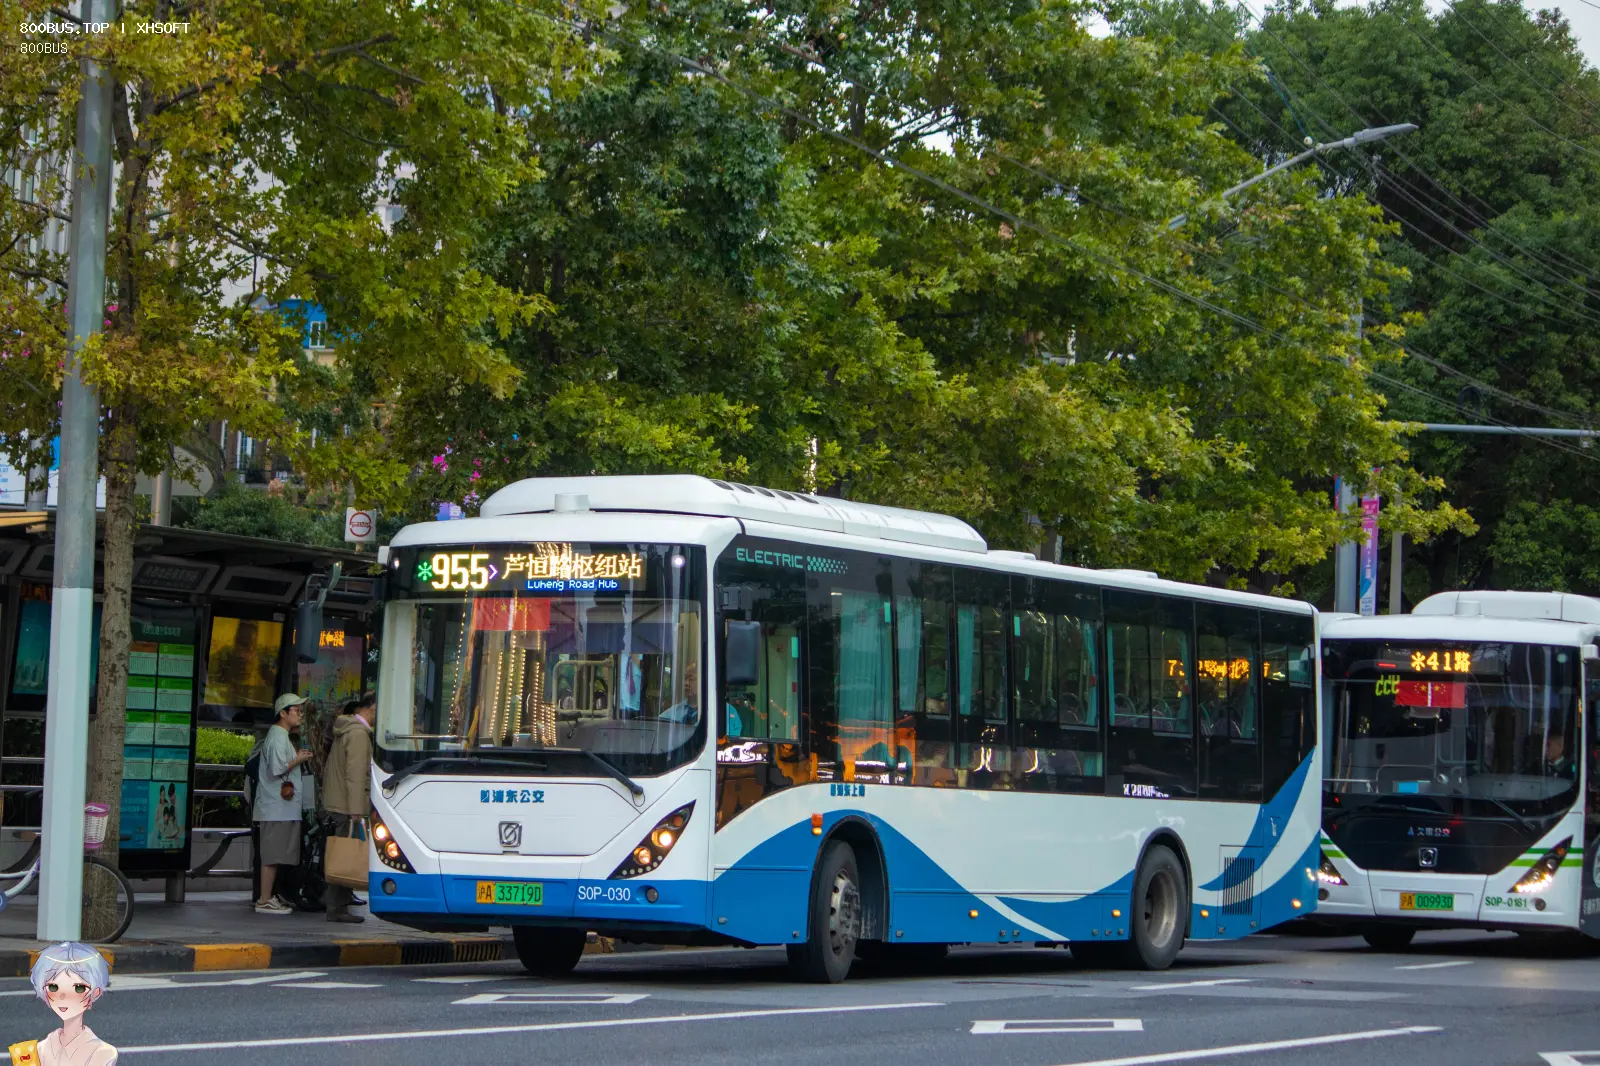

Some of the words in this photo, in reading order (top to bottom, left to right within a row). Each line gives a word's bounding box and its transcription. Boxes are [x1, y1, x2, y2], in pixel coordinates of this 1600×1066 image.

[502, 553, 642, 580] 芦恒路枢纽站
[736, 547, 804, 568] ELECTRIC
[431, 553, 489, 589] 955
[527, 580, 563, 591] Luheng
[569, 580, 595, 589] Road
[599, 579, 618, 589] Hub
